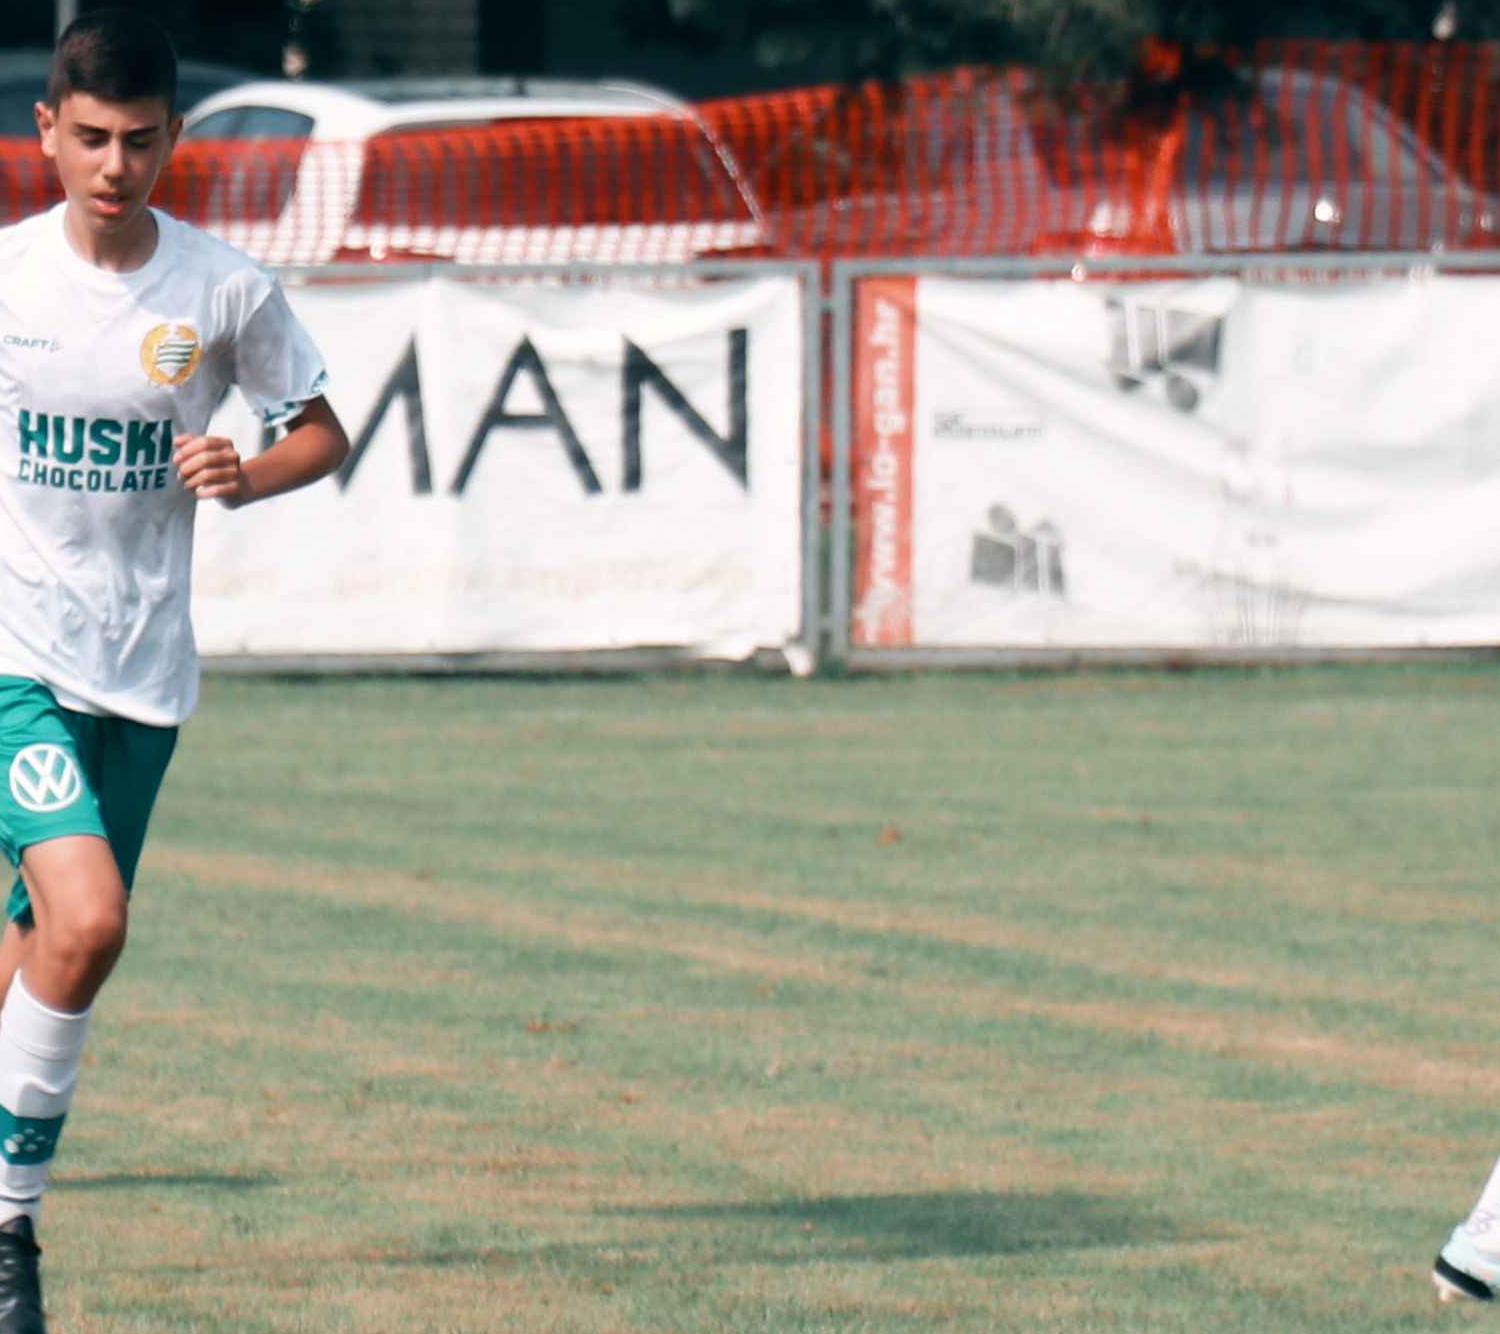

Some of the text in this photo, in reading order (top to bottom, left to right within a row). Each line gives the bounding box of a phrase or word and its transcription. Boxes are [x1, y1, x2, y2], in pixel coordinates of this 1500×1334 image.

[2, 333, 51, 350] CRAFT
[17, 408, 173, 467] HUSKI
[17, 458, 170, 493] CHOCOLATE
